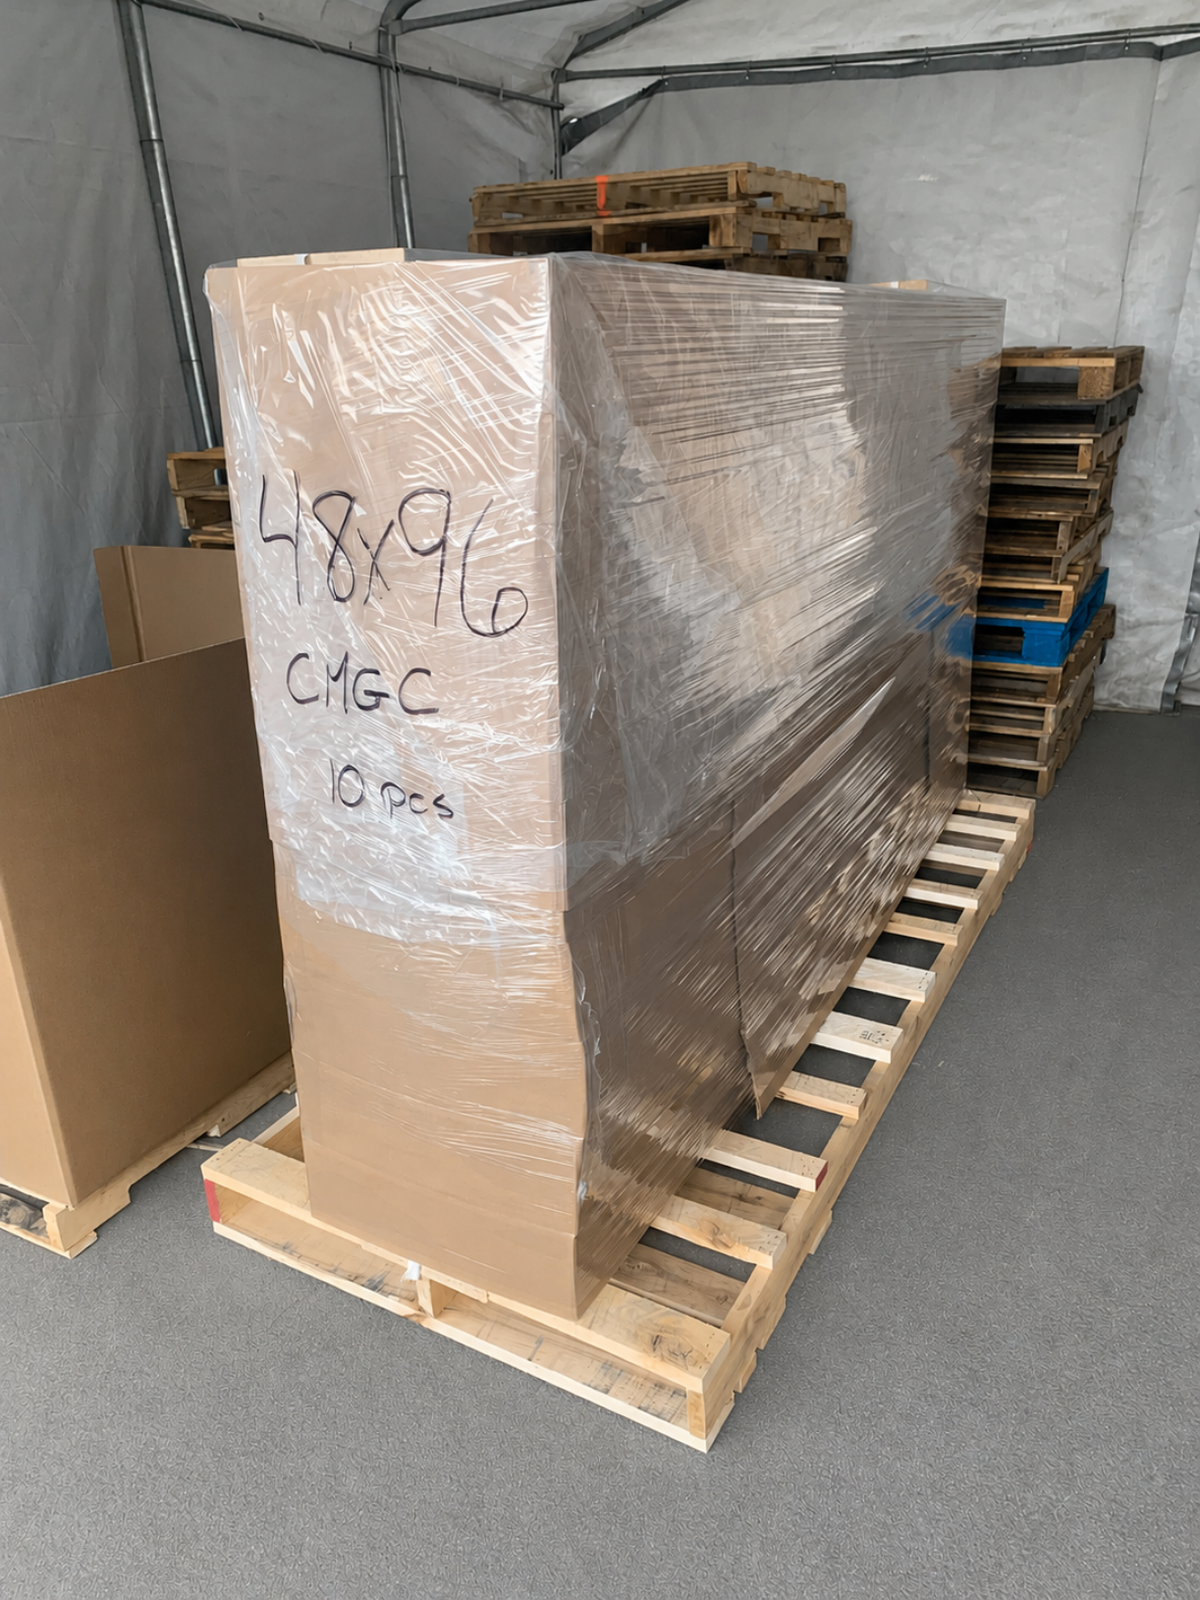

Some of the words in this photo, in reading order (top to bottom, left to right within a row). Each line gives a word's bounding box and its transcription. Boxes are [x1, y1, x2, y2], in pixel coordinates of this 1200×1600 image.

[259, 470, 529, 638] 48x96
[286, 651, 439, 715] CMGC
[329, 758, 366, 808] 10
[380, 781, 454, 820] pcs
